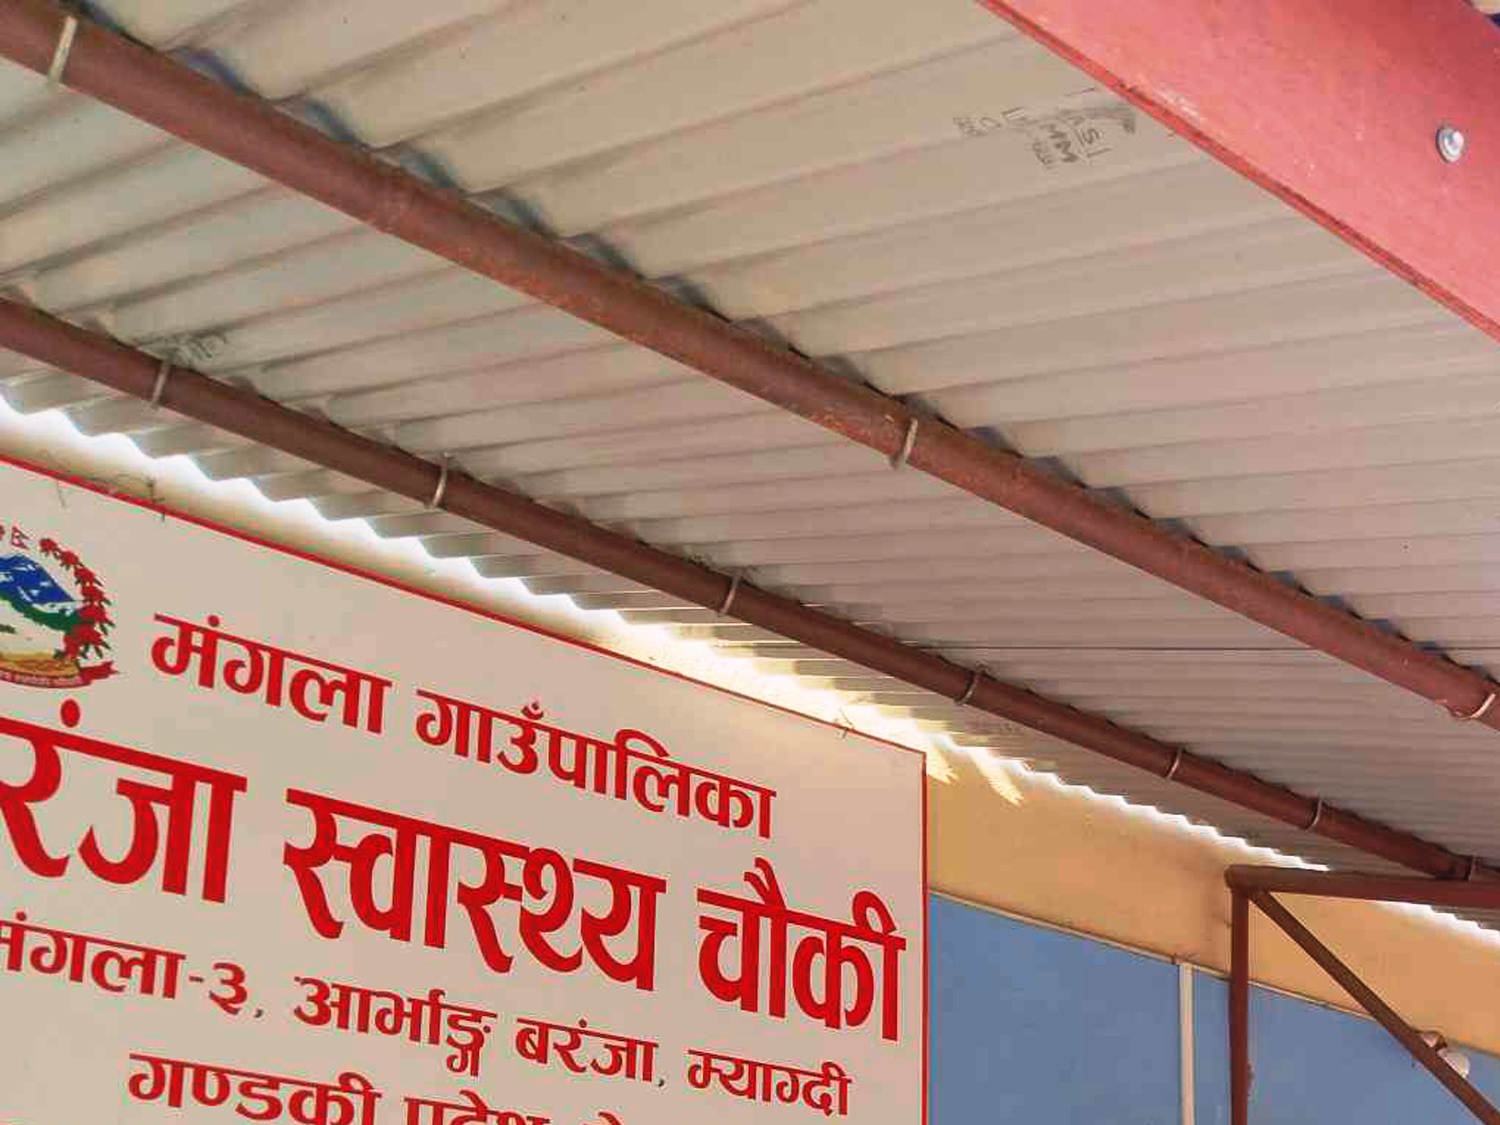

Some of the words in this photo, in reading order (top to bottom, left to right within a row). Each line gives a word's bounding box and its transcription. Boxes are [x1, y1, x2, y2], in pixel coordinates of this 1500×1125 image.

[151, 613, 392, 735] मंगला
[416, 689, 777, 839] गाउँपालिका
[284, 789, 667, 993] स्वास्थ्य
[696, 857, 907, 1042] चौकी
[687, 1048, 853, 1117] म्याग्दी
